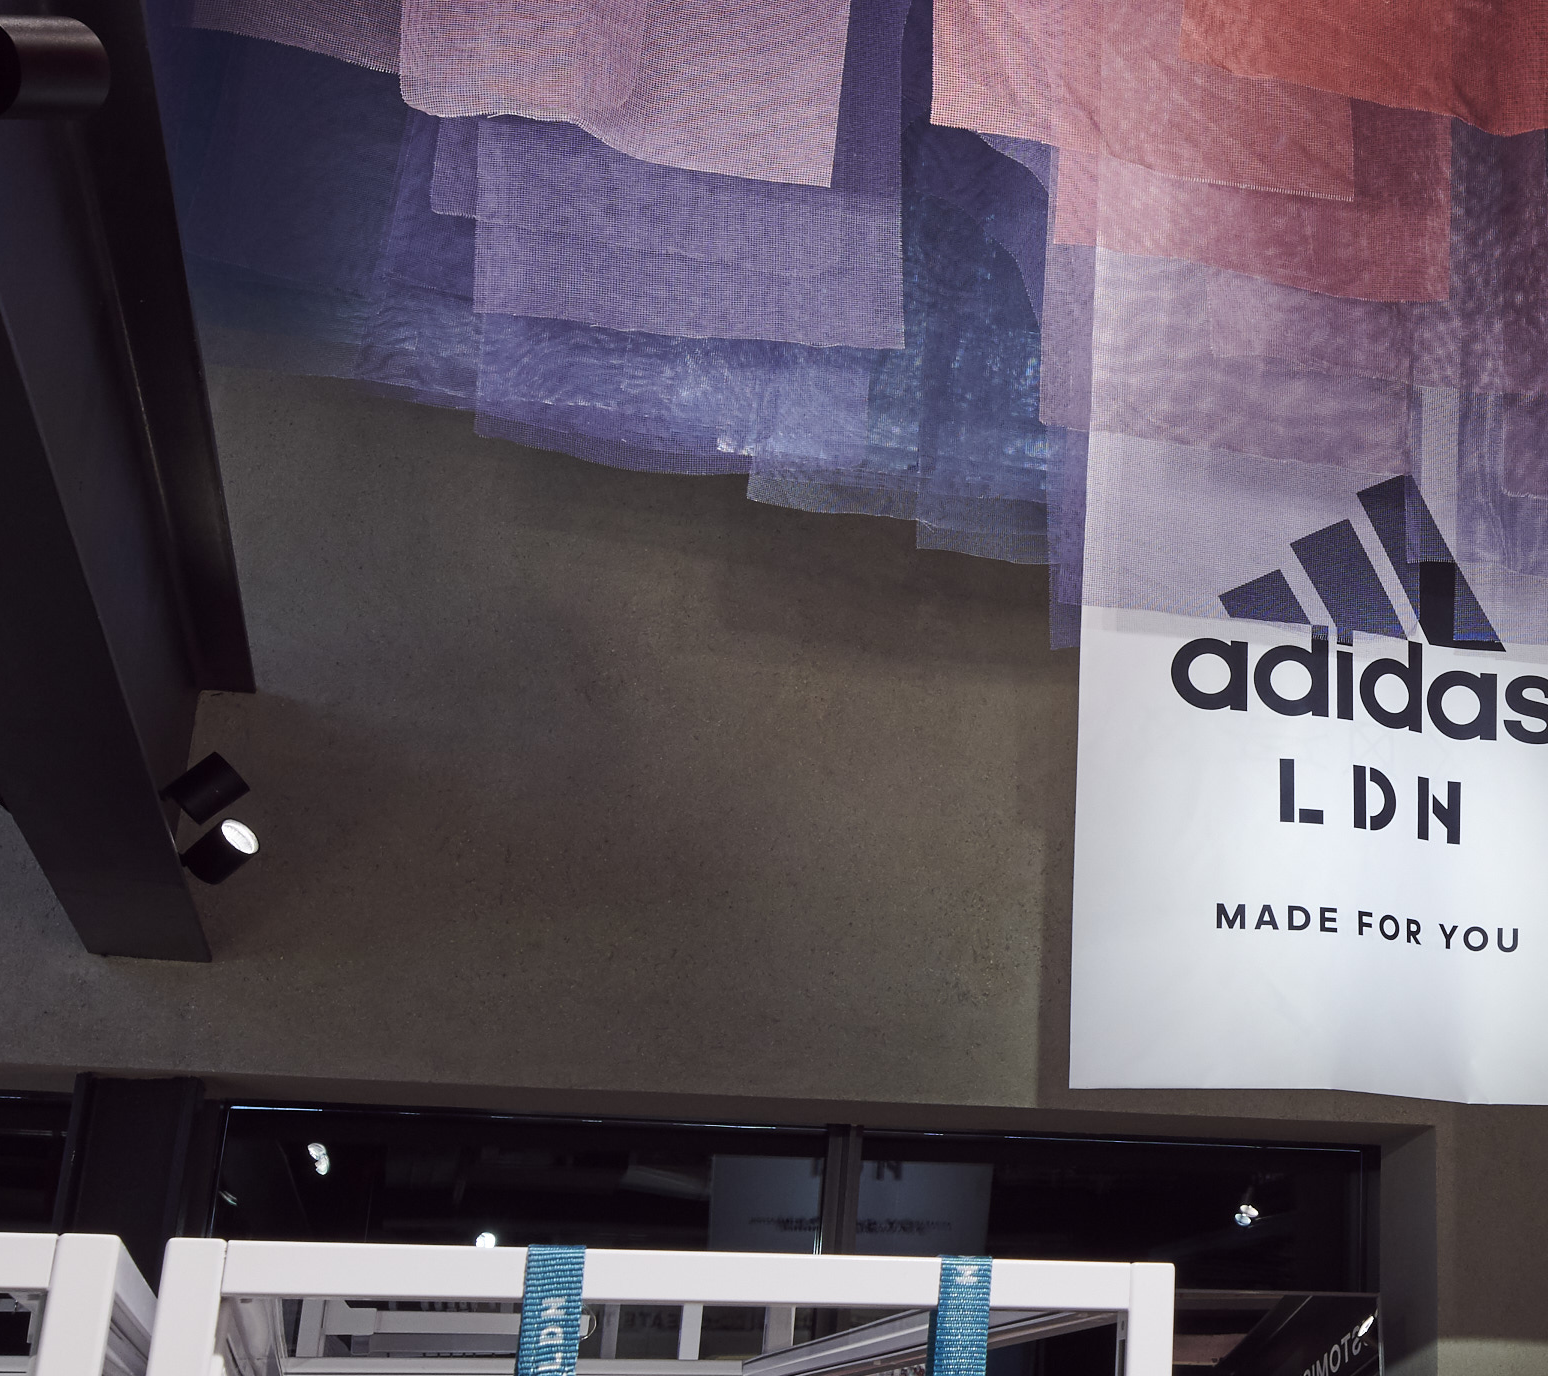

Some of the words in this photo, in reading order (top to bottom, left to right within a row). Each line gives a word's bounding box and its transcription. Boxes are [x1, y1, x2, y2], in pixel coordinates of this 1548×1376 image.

[1280, 759, 1461, 844] LDN
[1217, 903, 1337, 933] MADE
[1358, 911, 1421, 945] FOR
[1439, 924, 1518, 952] YOU
